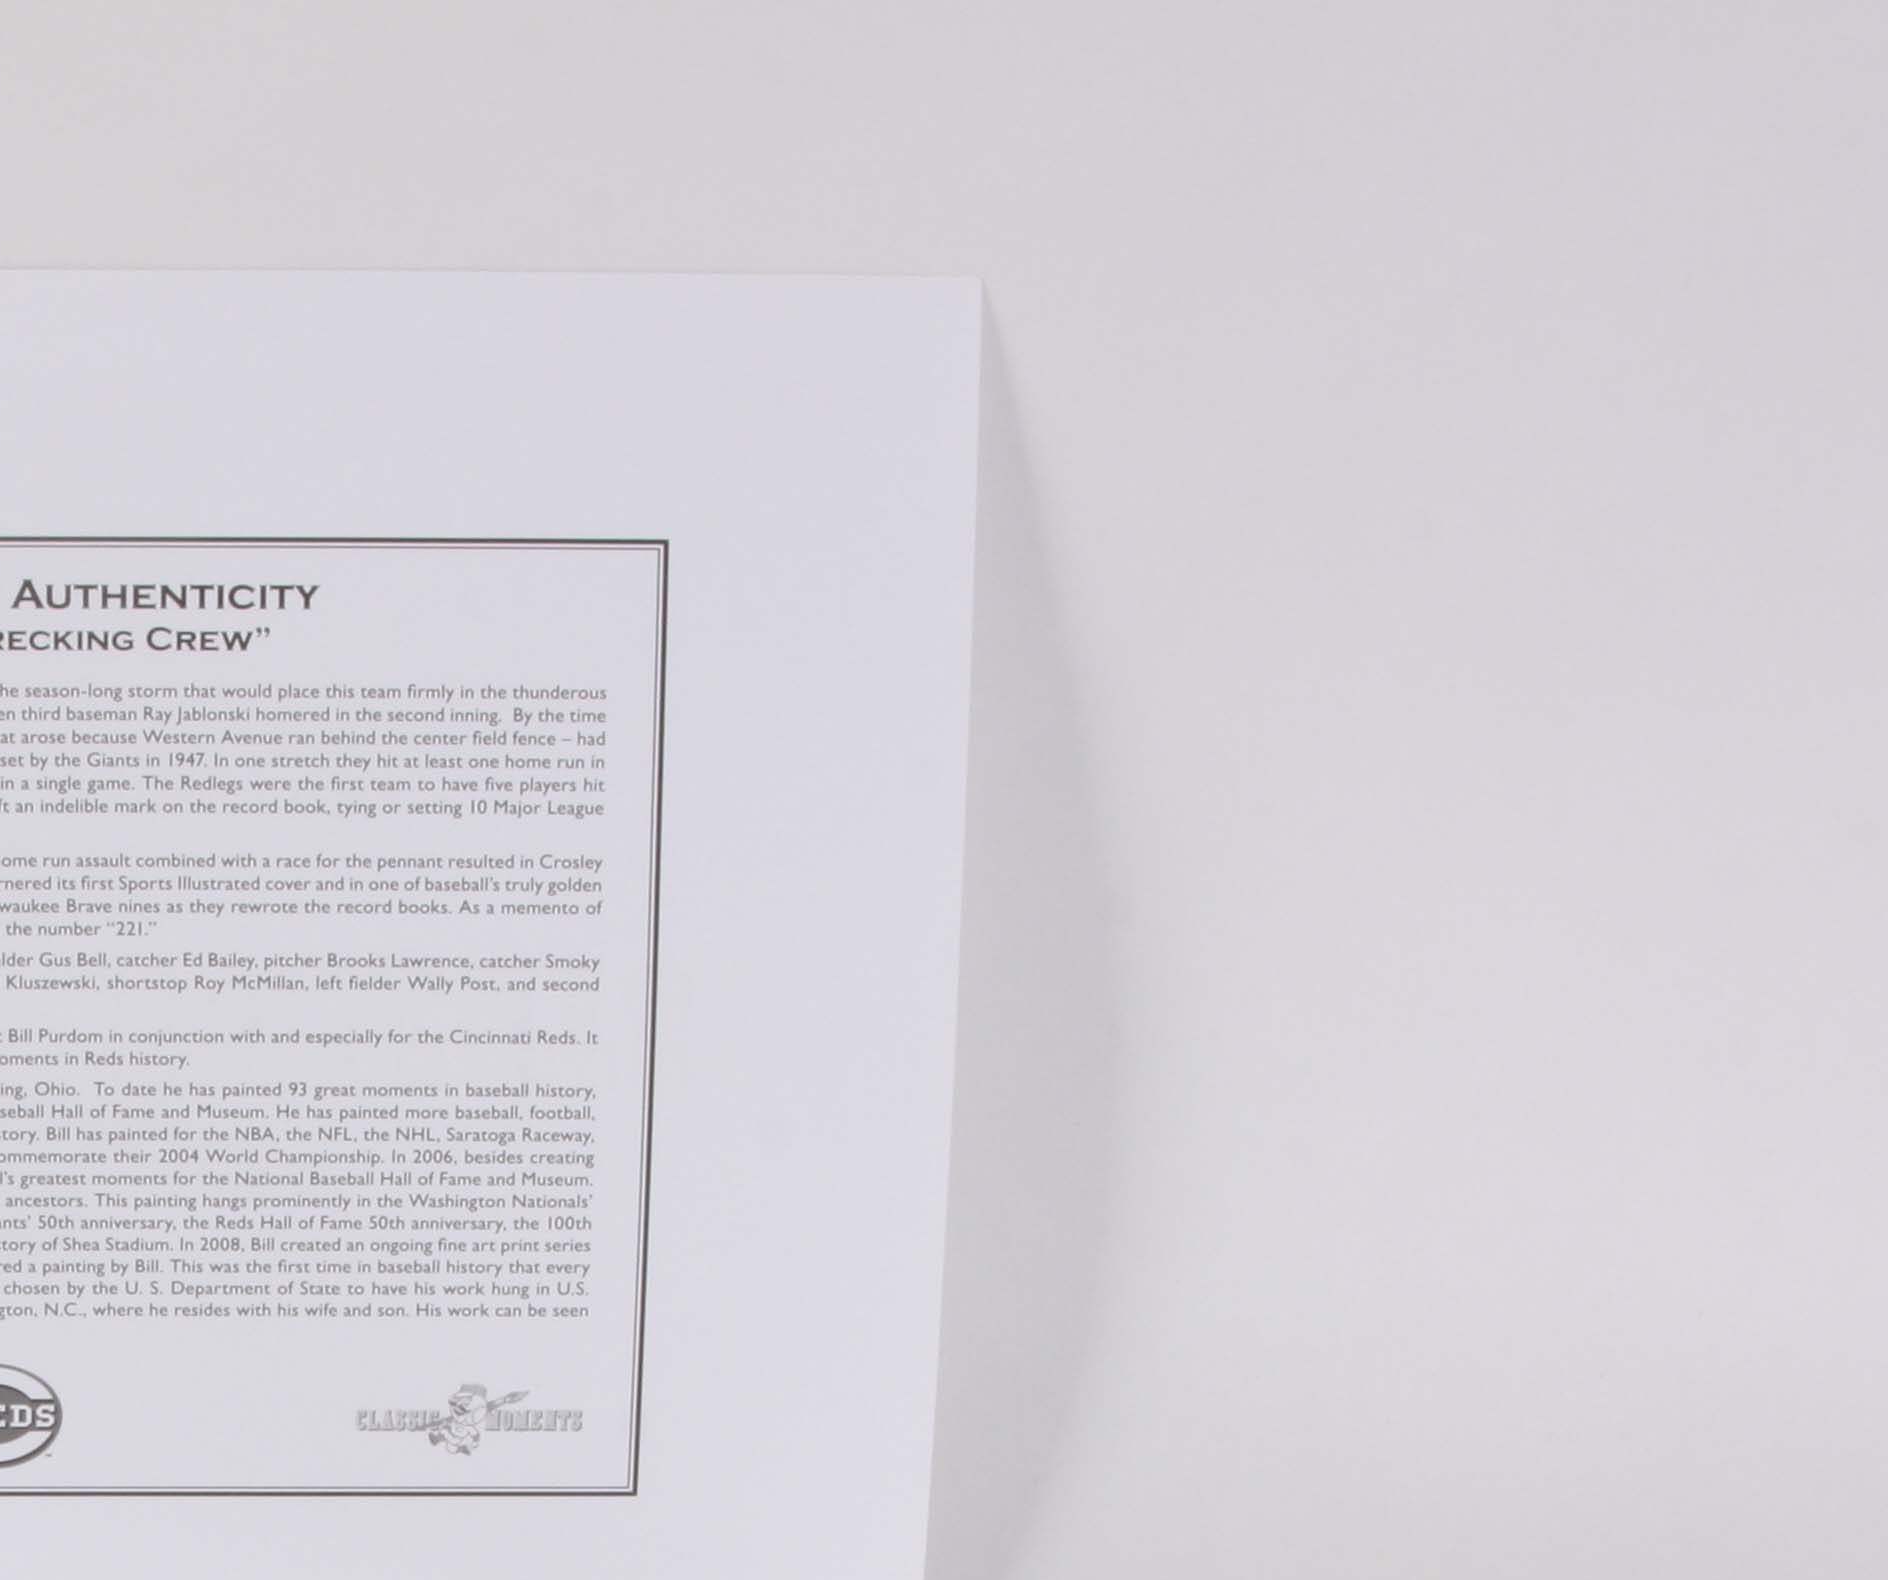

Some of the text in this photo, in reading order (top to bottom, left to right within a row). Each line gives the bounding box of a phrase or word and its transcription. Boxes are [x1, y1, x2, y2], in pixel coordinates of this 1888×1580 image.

[10, 579, 320, 610] AUTHENTICITY
[24, 683, 123, 703] season-long
[127, 686, 178, 698] storm
[183, 682, 216, 699] that
[222, 683, 272, 699] would
[278, 683, 320, 703] place
[325, 683, 355, 699] this
[360, 687, 402, 699] team
[407, 683, 455, 703] firmly
[460, 685, 475, 700] in
[480, 684, 507, 700] the
[512, 684, 608, 700] thunderous
[41, 1236, 59, 1252] of
[62, 1237, 100, 1252] Shea
[180, 1236, 194, 1252] In
[251, 1237, 275, 1252] Bill
[280, 1237, 341, 1252] created
[346, 1241, 365, 1252] an
[370, 1239, 433, 1257] ongoing
[438, 1237, 467, 1252] fine
[472, 1240, 496, 1252] art
[500, 1239, 540, 1256] print
[544, 1239, 591, 1253] series
